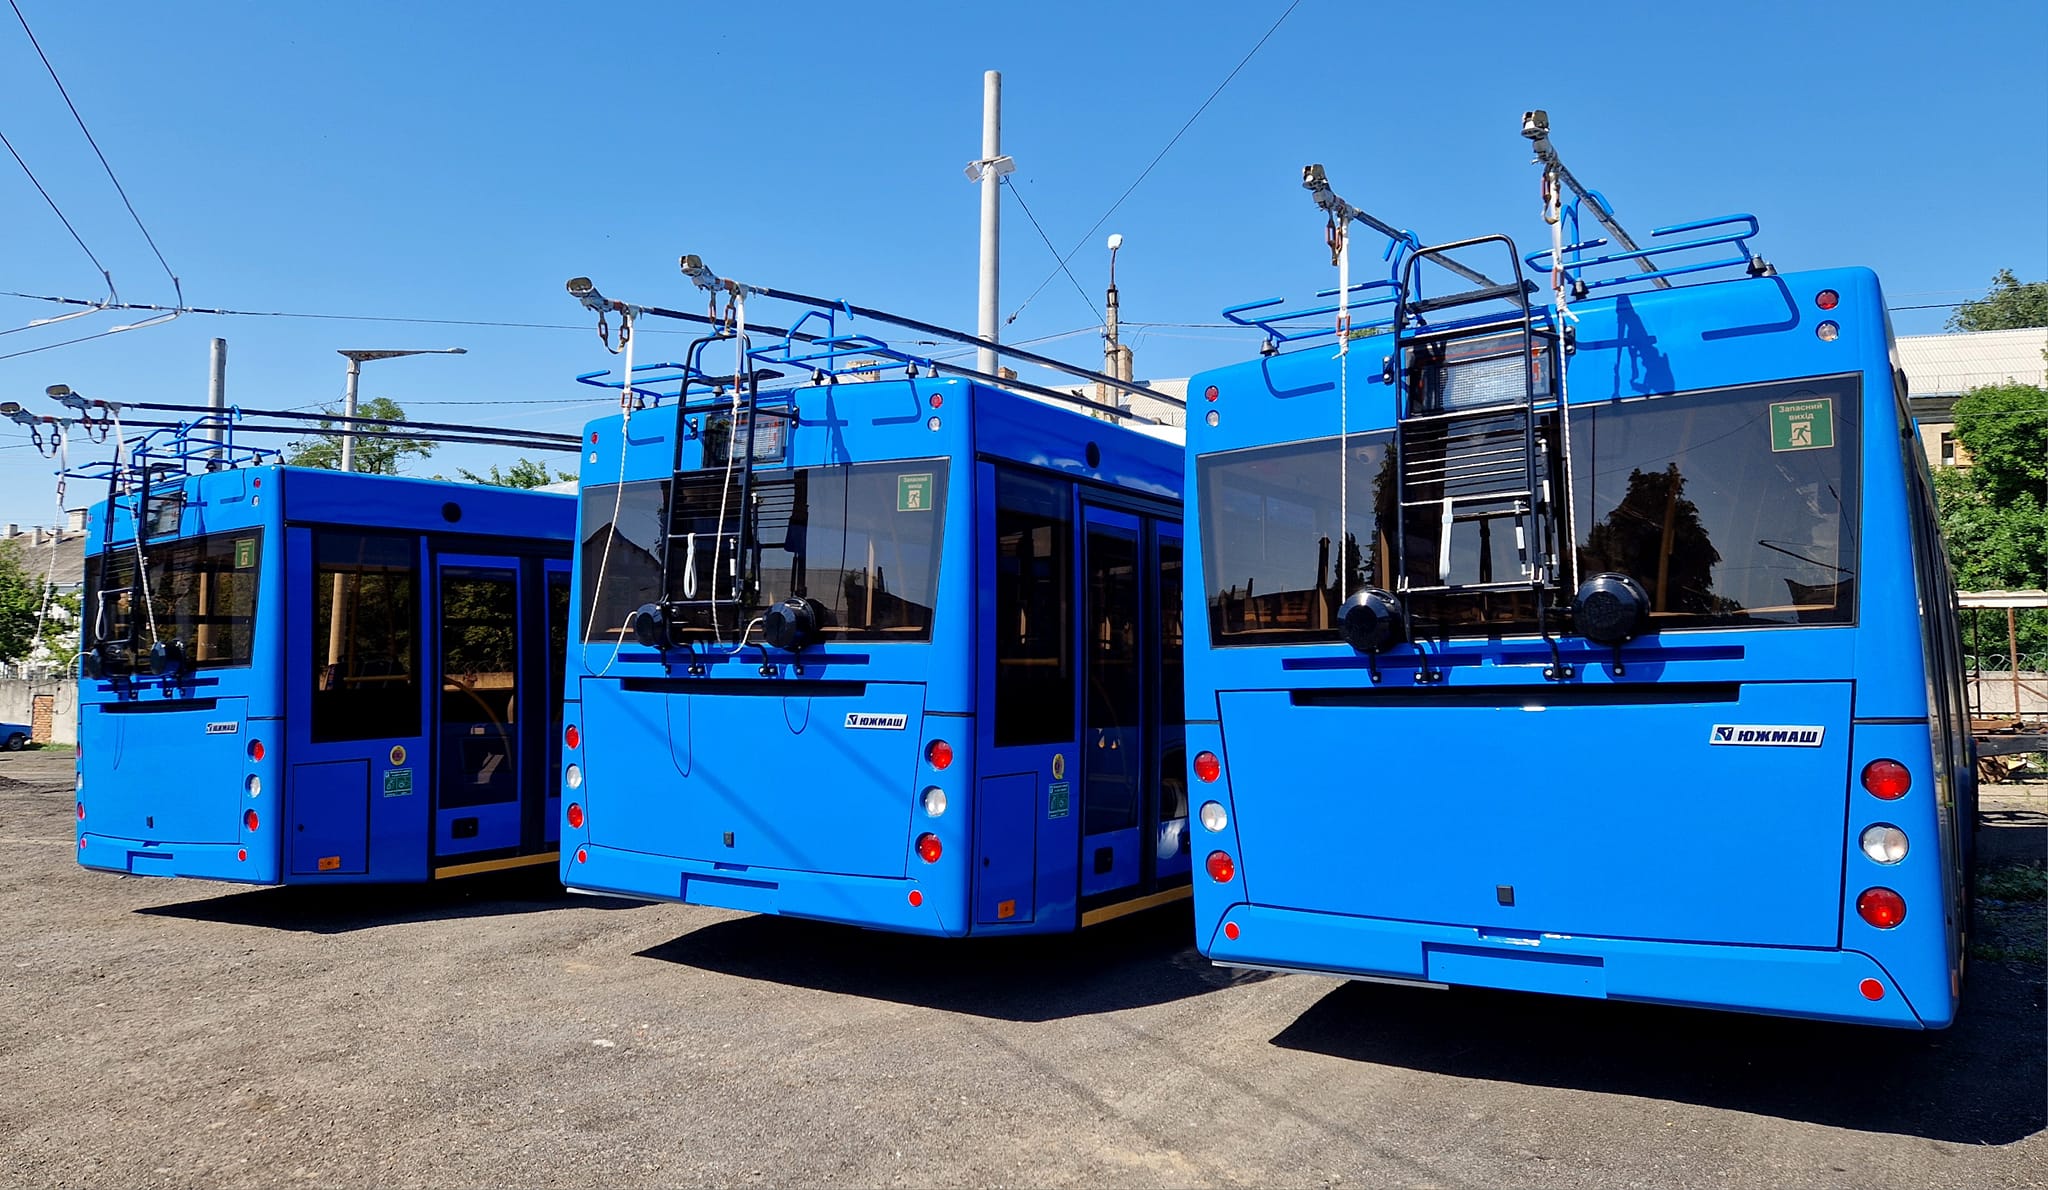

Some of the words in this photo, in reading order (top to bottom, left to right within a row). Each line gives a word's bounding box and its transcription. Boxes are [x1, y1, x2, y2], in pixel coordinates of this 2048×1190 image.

[1778, 402, 1823, 413] Запасний
[1788, 412, 1815, 421] вихід
[859, 717, 904, 727] ЮЖМАШ
[1737, 730, 1818, 743] ЮЖМАШ
